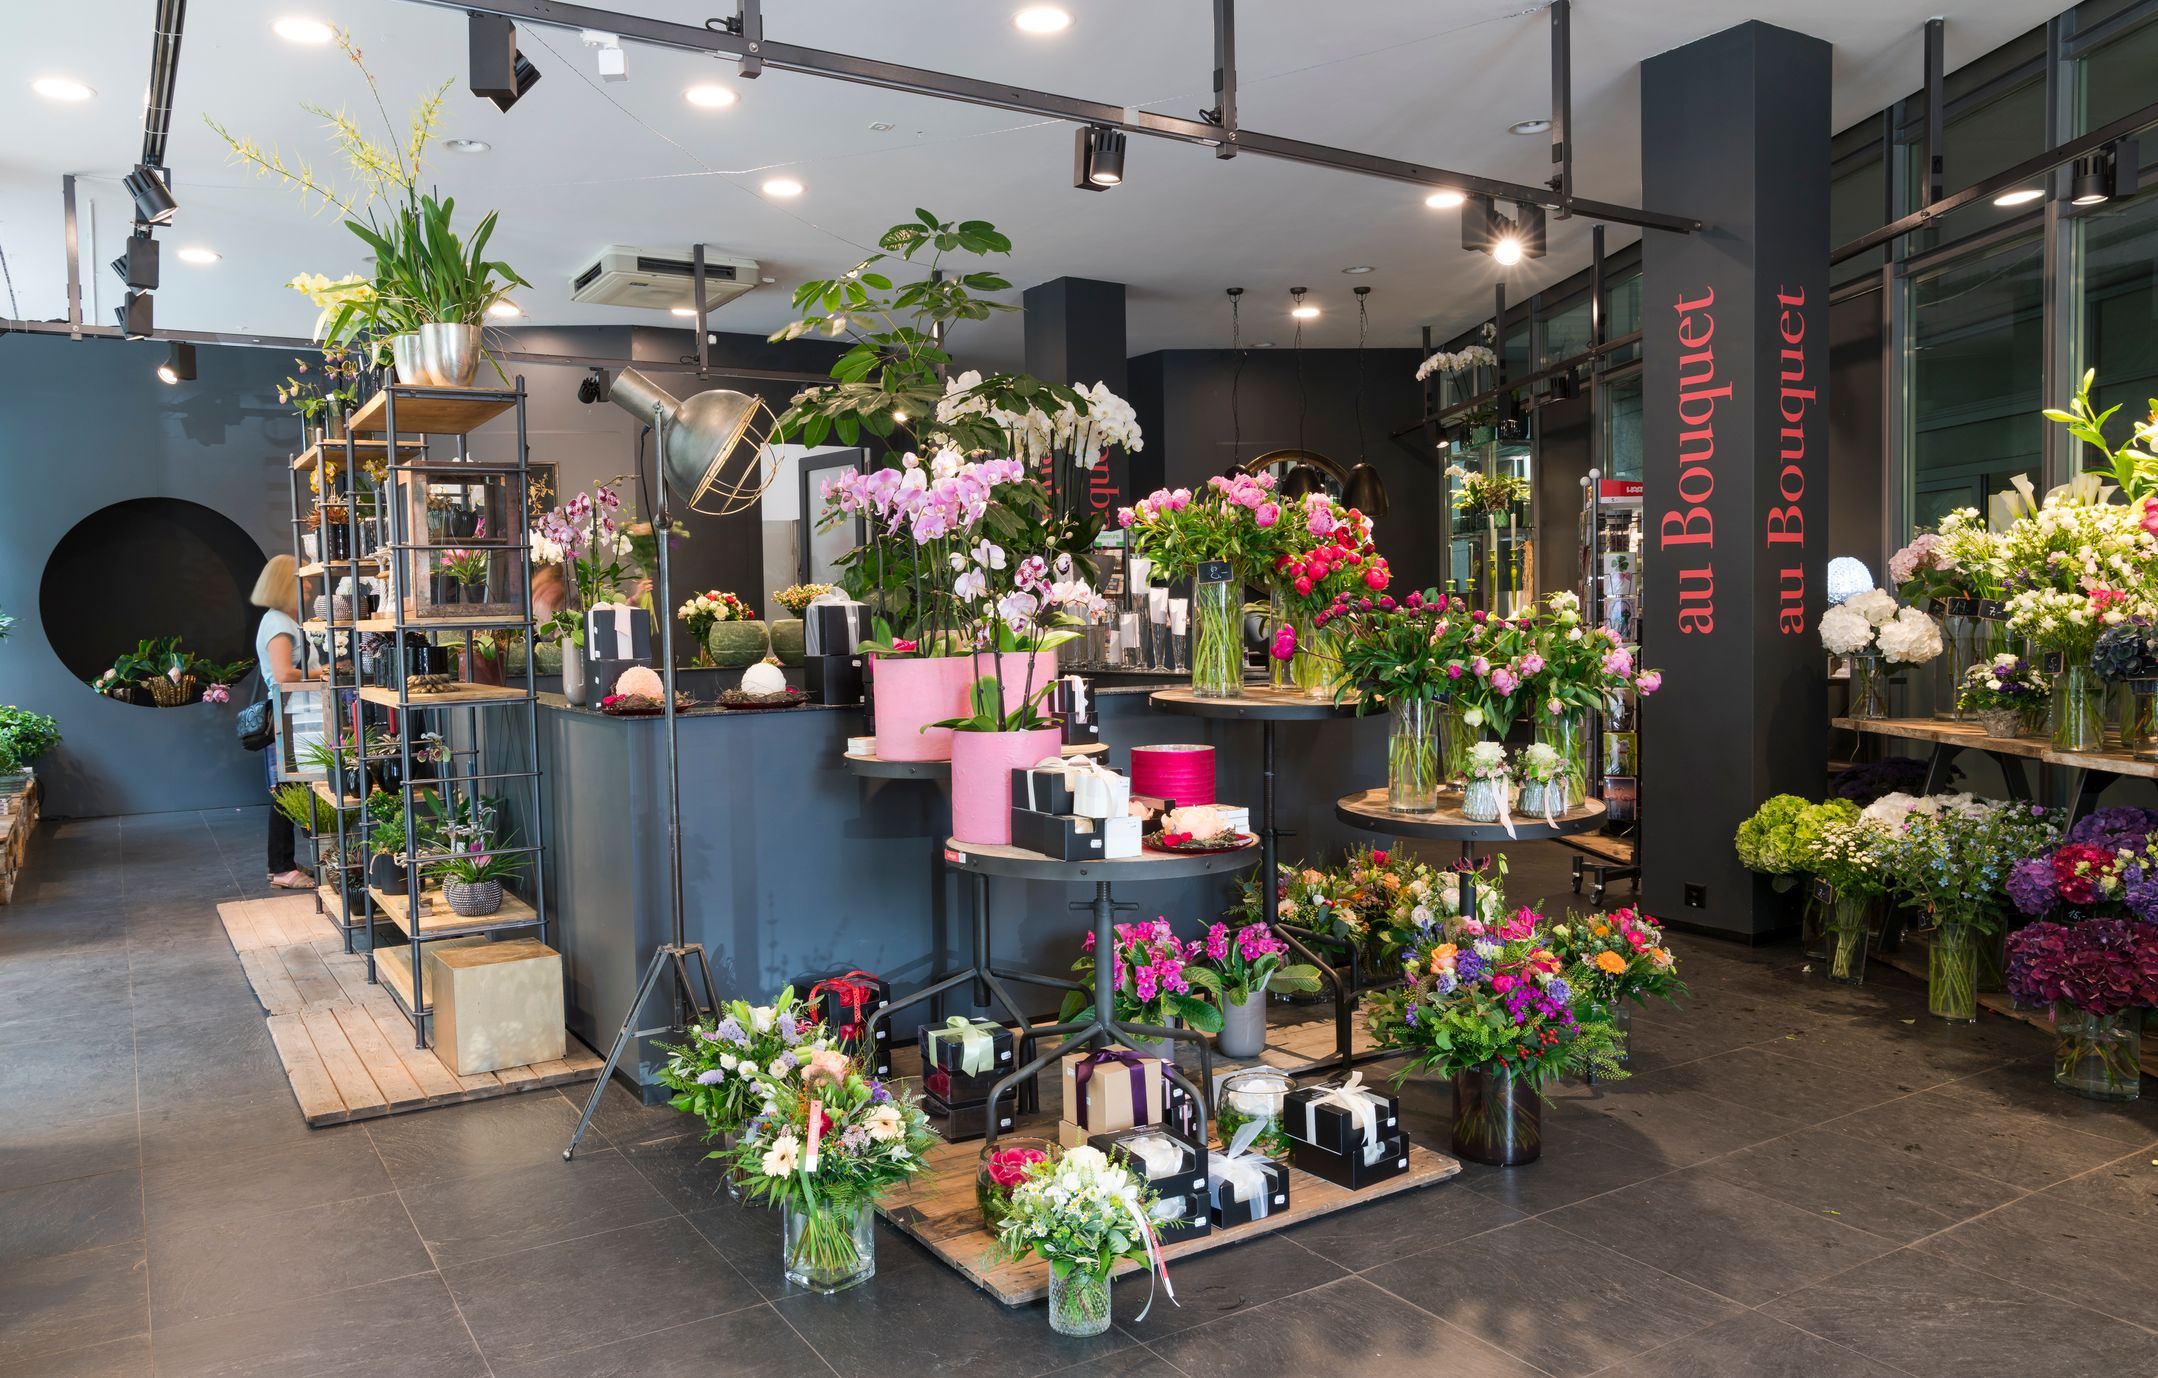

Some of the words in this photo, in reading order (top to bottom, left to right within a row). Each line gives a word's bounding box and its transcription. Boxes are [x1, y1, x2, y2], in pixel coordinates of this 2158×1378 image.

[1661, 286, 1733, 551] Bouquet
[1767, 284, 1817, 549] Bouquet
[1678, 562, 1715, 635] au
[1779, 562, 1804, 635] au
